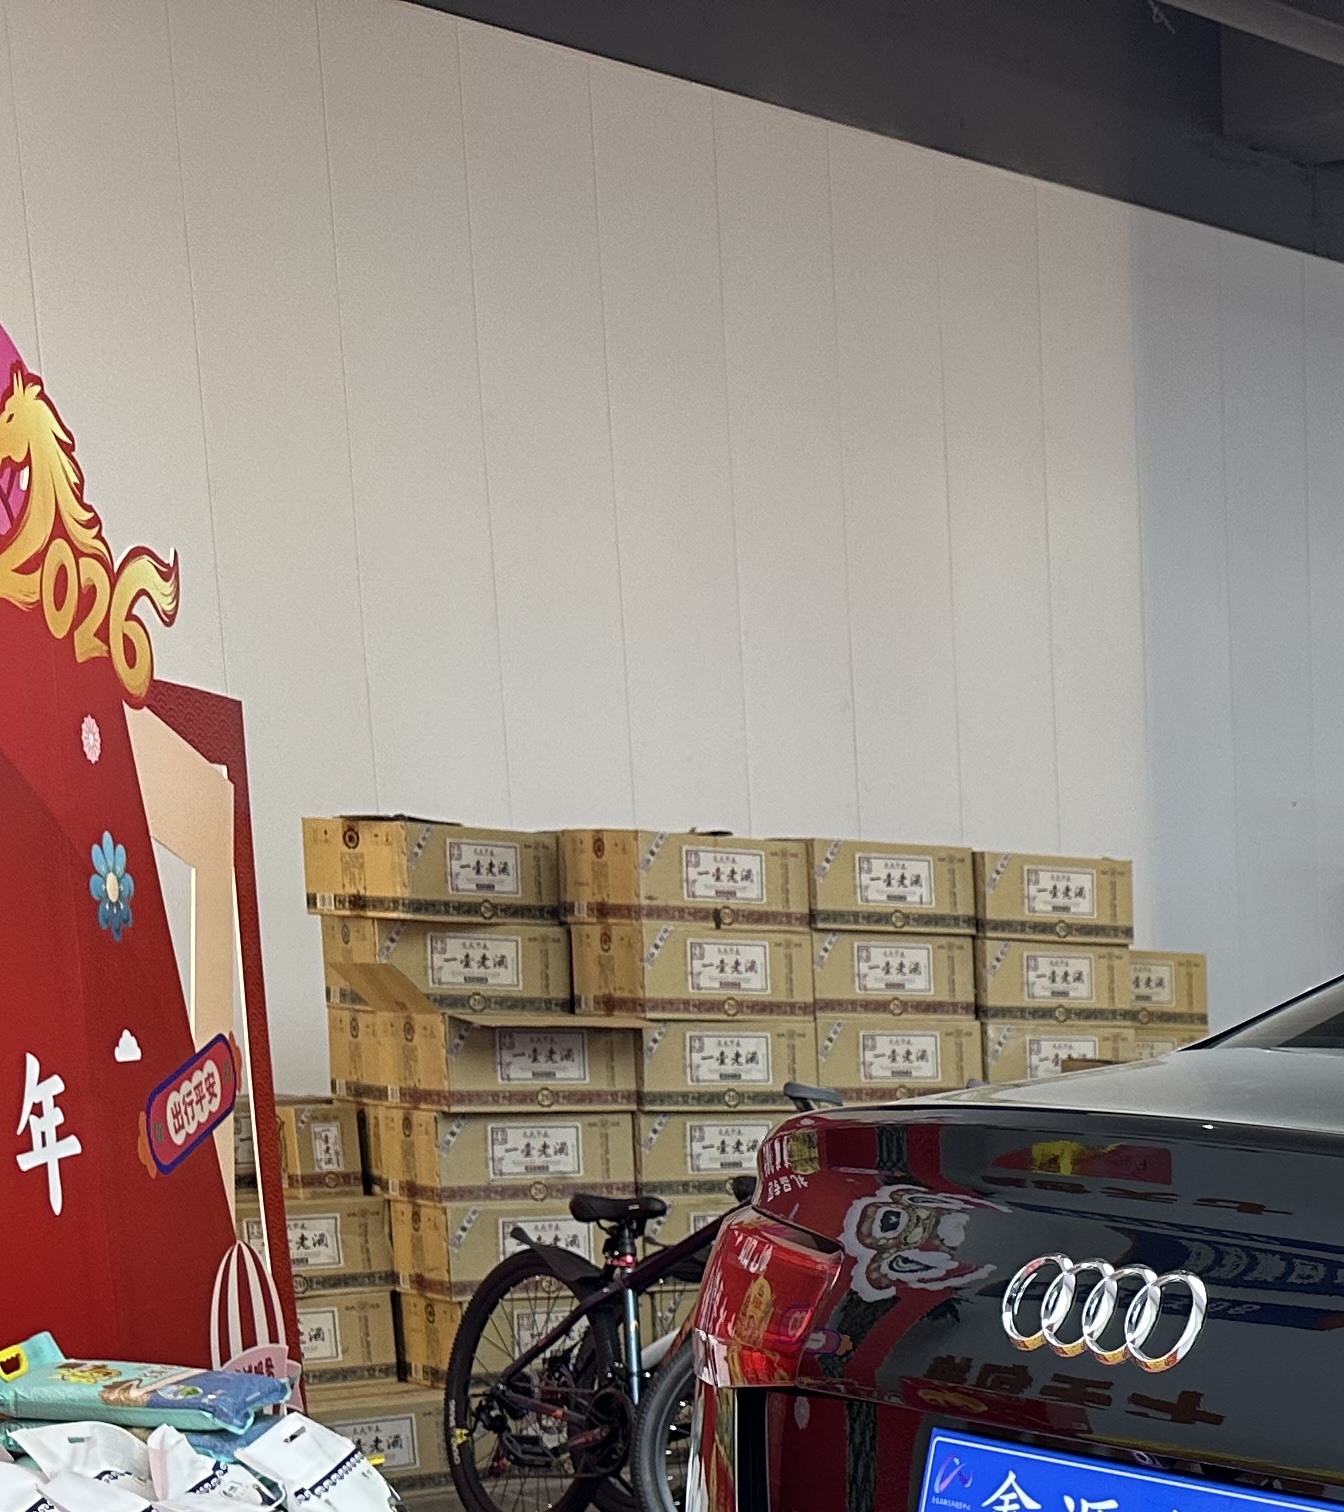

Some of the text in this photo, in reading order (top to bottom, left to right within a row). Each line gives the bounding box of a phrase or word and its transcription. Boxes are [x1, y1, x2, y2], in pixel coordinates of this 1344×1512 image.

[16, 1052, 82, 1216] 年
[170, 1070, 219, 1134] 出行平安
